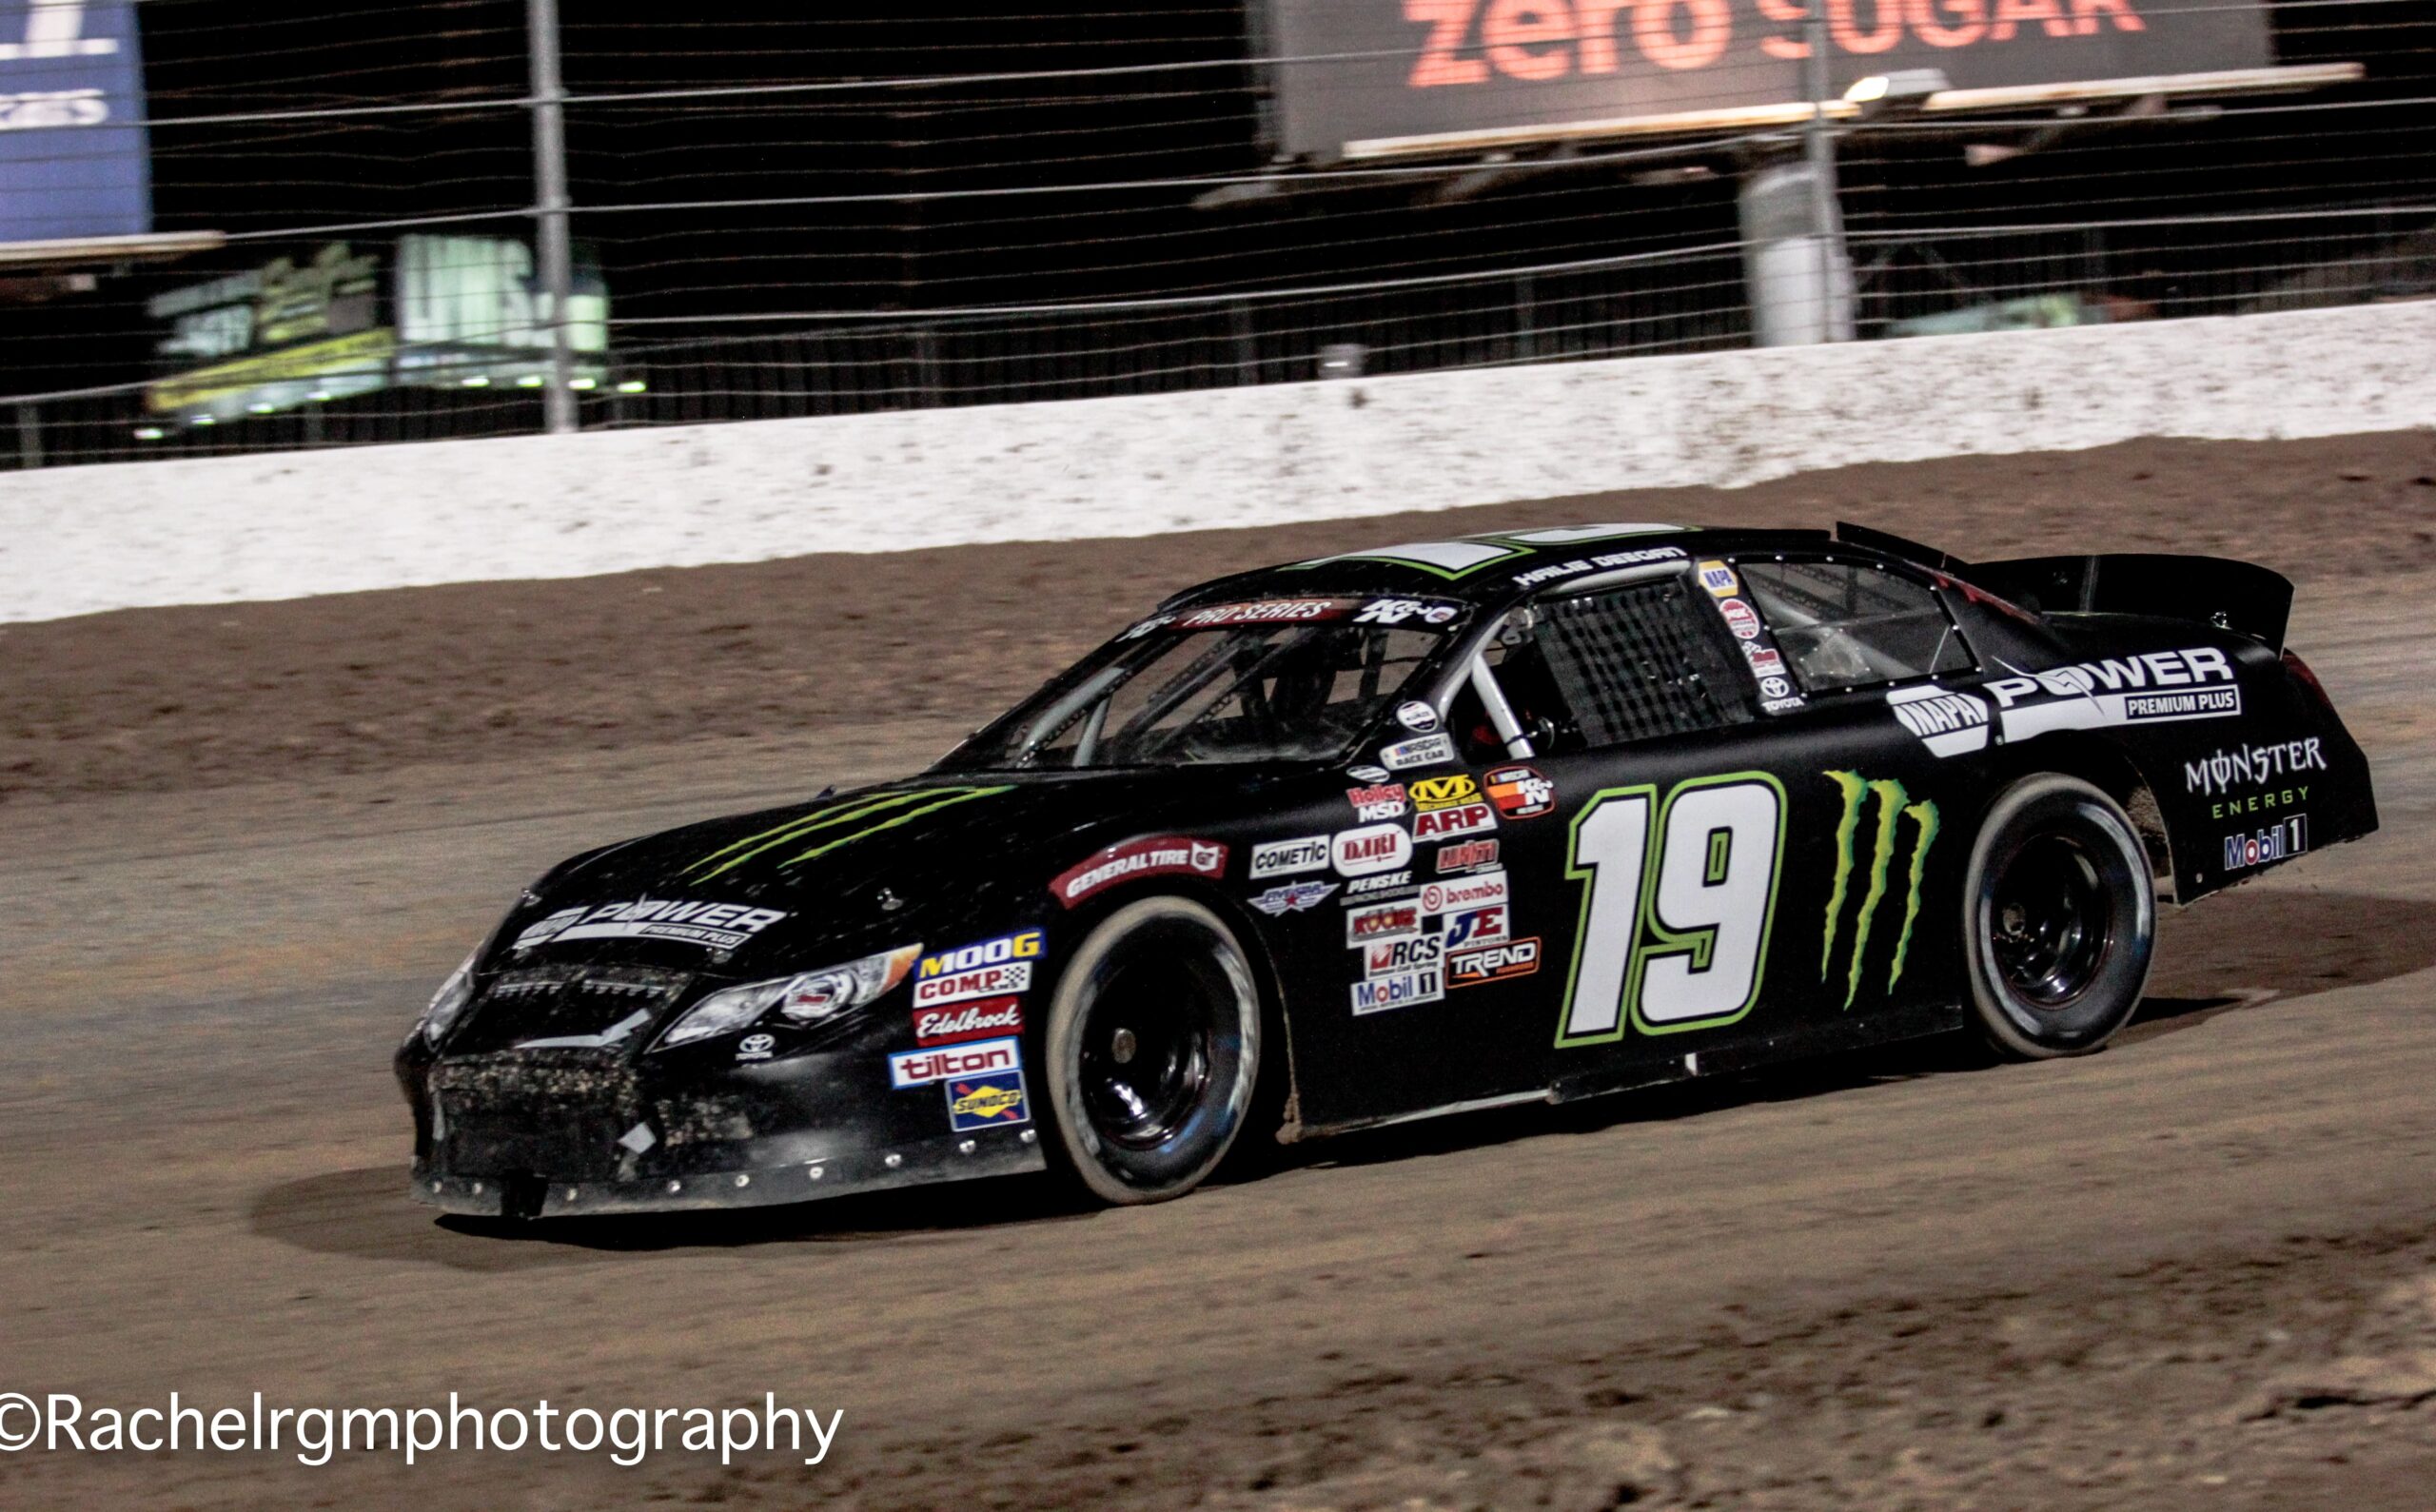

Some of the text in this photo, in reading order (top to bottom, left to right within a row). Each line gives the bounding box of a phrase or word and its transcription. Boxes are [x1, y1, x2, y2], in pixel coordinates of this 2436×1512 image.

[1403, 0, 1732, 87] zero
[1512, 546, 1687, 585] HAILIE DEEGAN
[1704, 570, 1736, 588] NAPA
[1183, 601, 1331, 626] PRO SERIES
[1983, 647, 2234, 708] POWER
[1761, 697, 1804, 712] TOYOTA
[1909, 695, 1980, 736] NAPA
[2128, 691, 2235, 716] PREMIUM PLUS
[1395, 750, 1445, 766] RACE CAR
[2185, 736, 2328, 796] MONSTER
[1346, 782, 1406, 807] Holley
[2211, 786, 2308, 819] ENERGY
[1359, 801, 1406, 823] MSD
[1416, 805, 1490, 836] ARP
[2225, 825, 2284, 871] Mobil
[1067, 853, 1149, 897] GENERAL
[1149, 850, 1189, 867] TIRE
[1346, 871, 1413, 893] PENSKE
[1446, 882, 1503, 903] brembo
[578, 900, 788, 933] POWER
[1557, 772, 1786, 1047] 19
[645, 925, 742, 945] PREMIUM PLUS
[1445, 906, 1503, 948] JE
[919, 933, 1040, 978] MOOG
[1391, 937, 1441, 966] RCS
[1451, 943, 1536, 977] TREND
[920, 970, 1002, 999] COMP
[1358, 976, 1413, 1006] Mobil
[1420, 972, 1435, 994] 1
[916, 1005, 1021, 1038] Edelbrock
[901, 1050, 1010, 1079] tilton
[957, 1092, 1018, 1111] SUNOCO
